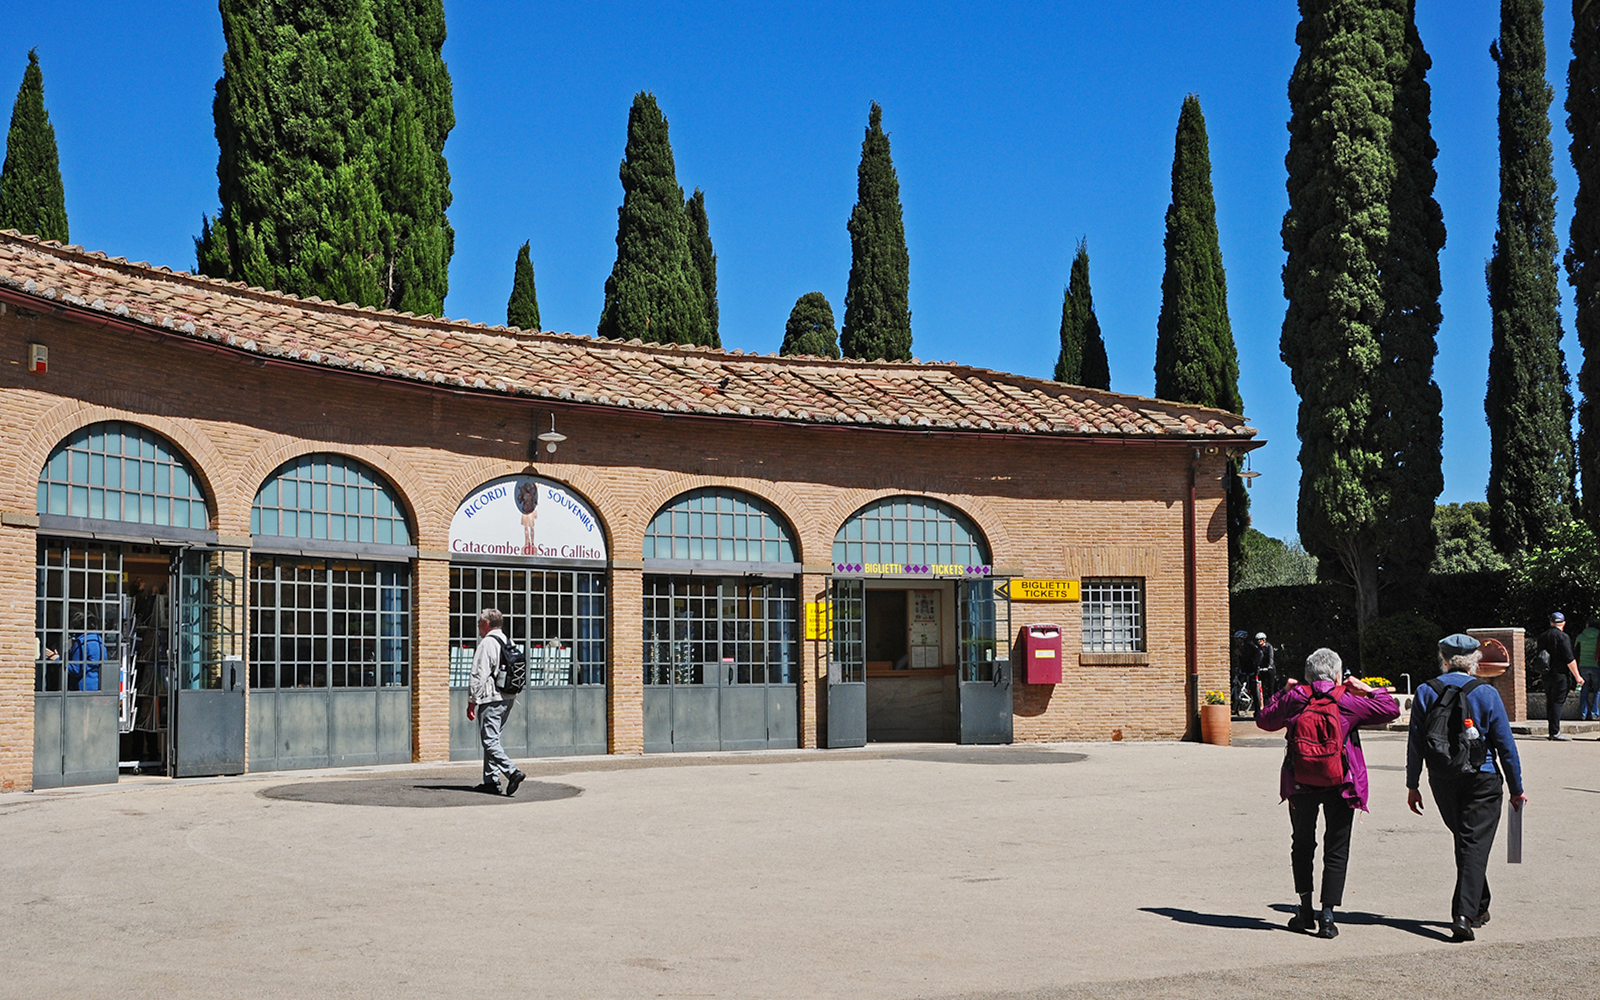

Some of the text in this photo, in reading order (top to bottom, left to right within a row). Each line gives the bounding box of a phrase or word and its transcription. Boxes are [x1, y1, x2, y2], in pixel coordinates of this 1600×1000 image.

[464, 486, 507, 519] RICORDI
[547, 489, 595, 533] SOUVENIRS
[452, 538, 601, 560] Catacombe di San Callisto
[864, 563, 964, 576] BIGLIETTI TICKETS
[1021, 581, 1070, 590] BIGLIETTI
[1024, 590, 1068, 598] TICKETS
